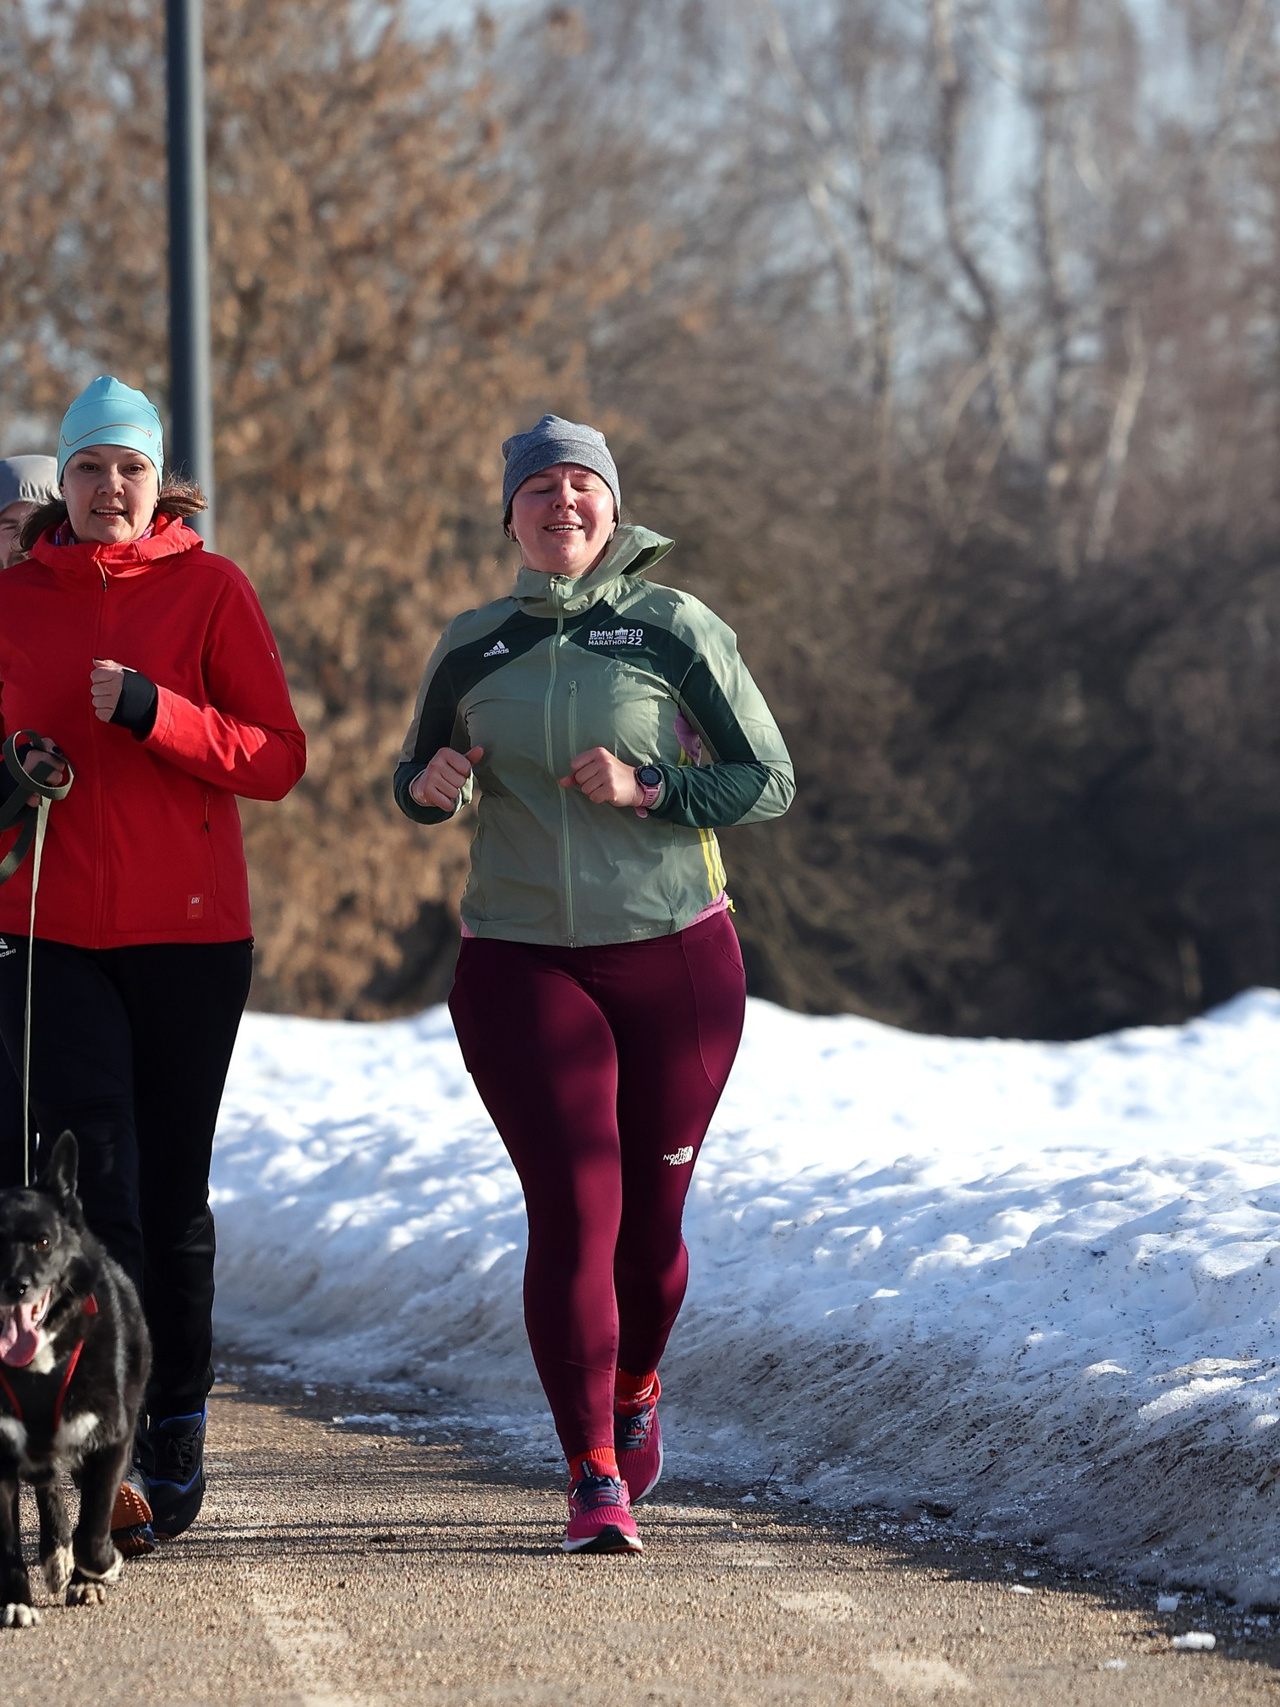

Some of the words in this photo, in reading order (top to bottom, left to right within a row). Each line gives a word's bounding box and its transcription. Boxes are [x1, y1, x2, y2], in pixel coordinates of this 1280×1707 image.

[590, 630, 614, 638] BMW
[628, 628, 644, 637] 20
[627, 636, 643, 646] 22
[483, 648, 509, 657] adidas
[663, 1152, 688, 1161] NORTH
[669, 1158, 687, 1166] FACE
